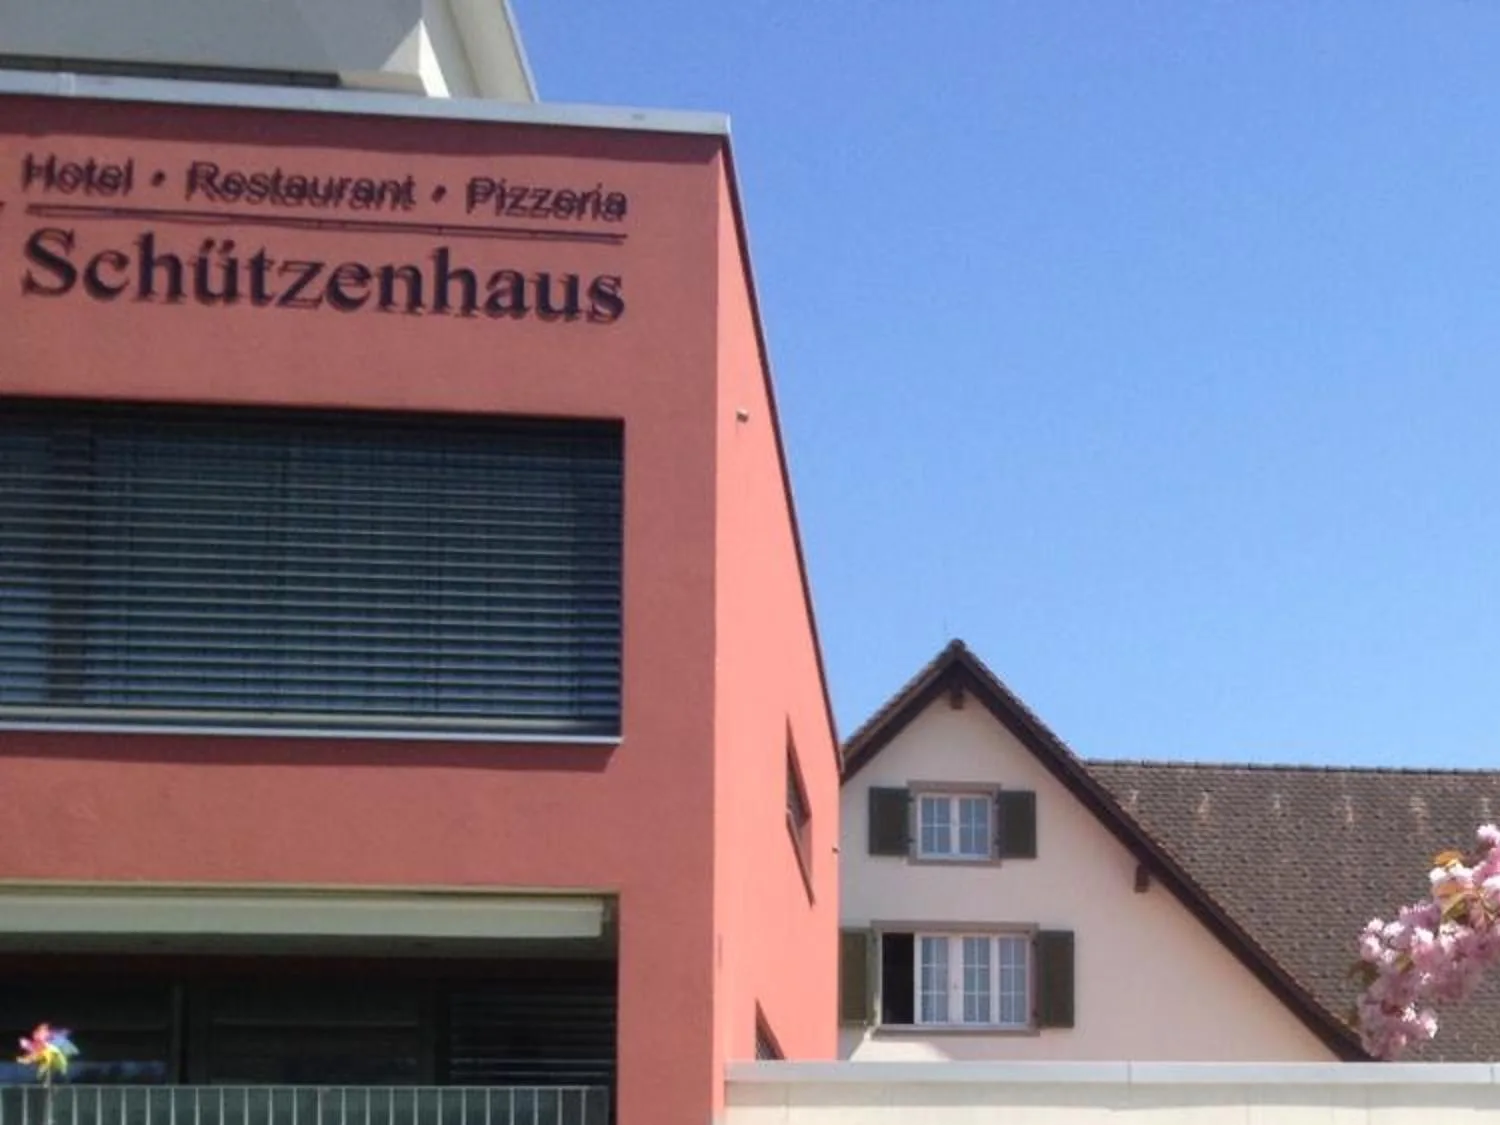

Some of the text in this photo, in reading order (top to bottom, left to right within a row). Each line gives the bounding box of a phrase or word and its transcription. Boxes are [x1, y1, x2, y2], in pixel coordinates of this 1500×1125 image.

[23, 153, 627, 221] Hotel Restaurant Pizzeria
[23, 227, 625, 323] Schützenhaus
